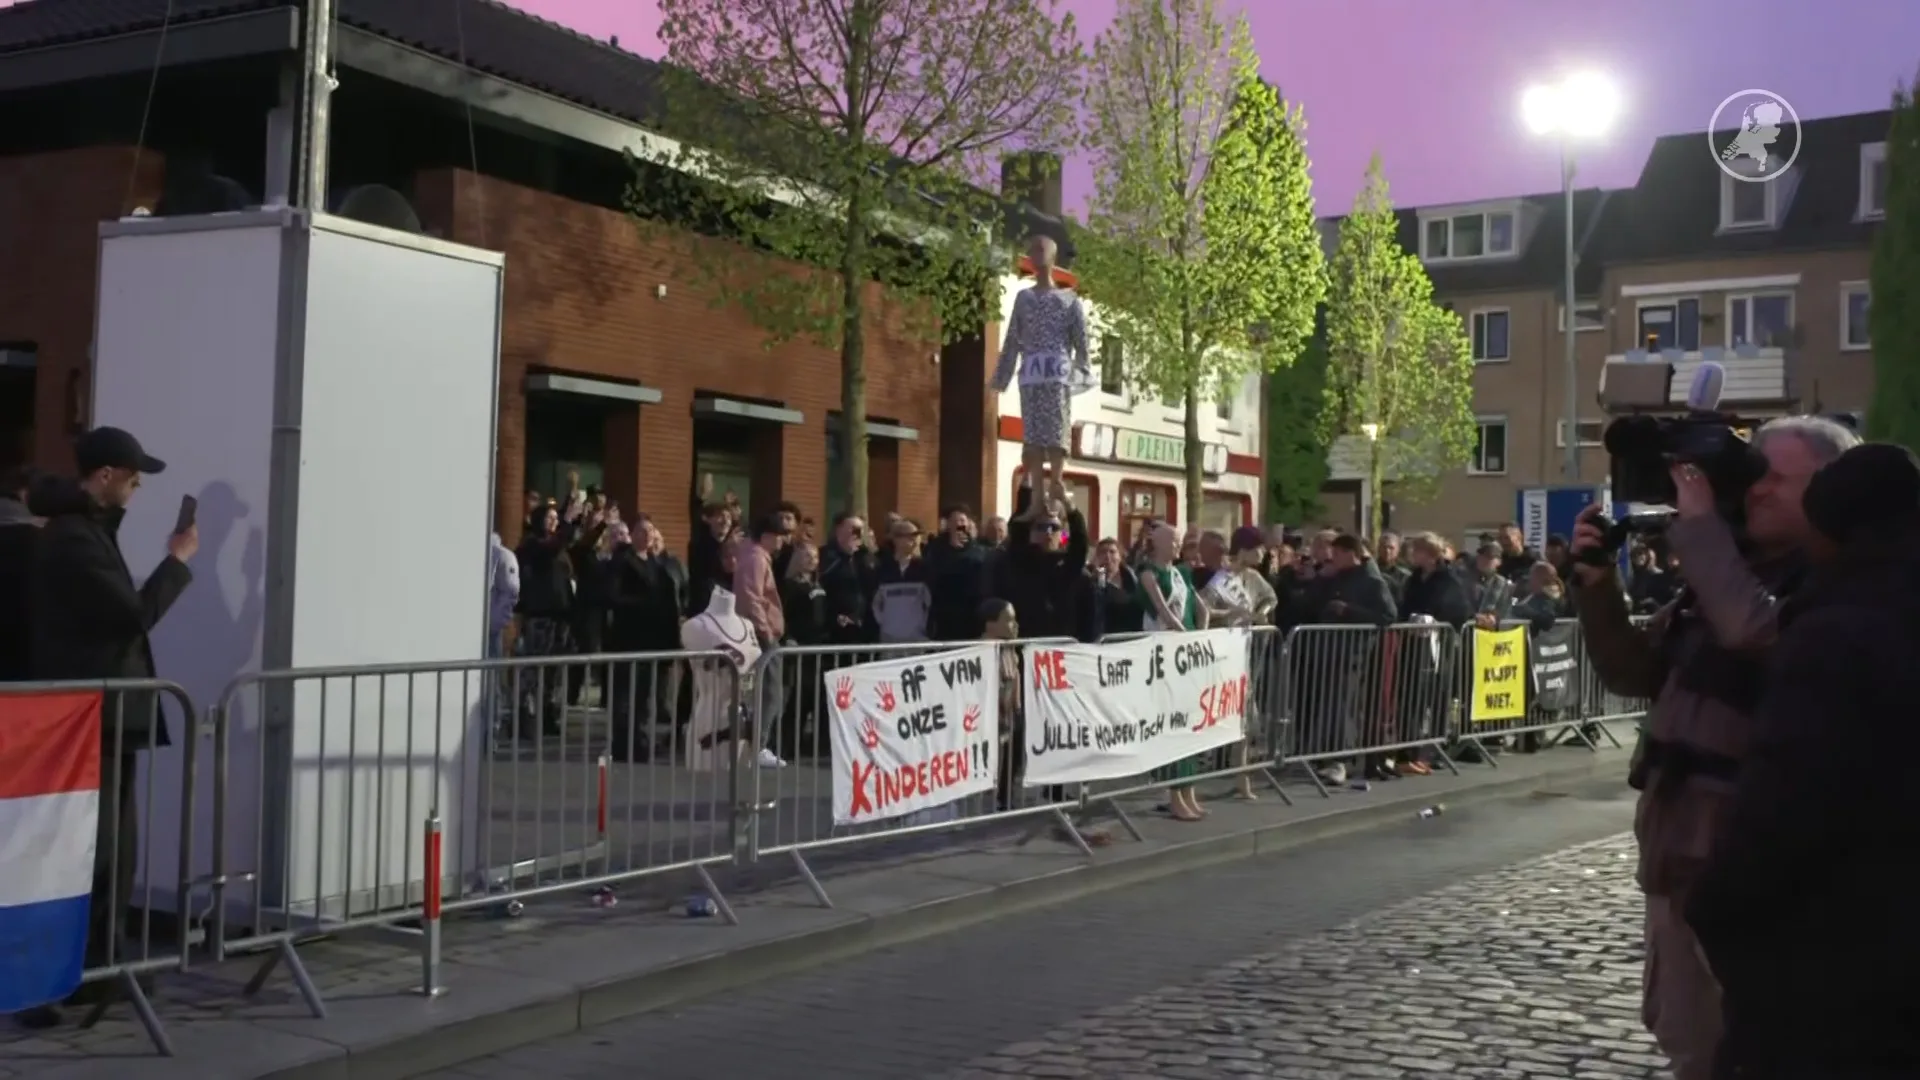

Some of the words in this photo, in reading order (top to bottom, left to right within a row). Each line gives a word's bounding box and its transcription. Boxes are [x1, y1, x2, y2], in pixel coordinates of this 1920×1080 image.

[1022, 355, 1068, 377] ARG
[1137, 434, 1184, 463] PLEINT
[901, 665, 926, 702] AF
[940, 656, 981, 689] VAN
[1034, 650, 1067, 689] ME
[1098, 654, 1132, 687] LAAT
[897, 704, 947, 739] ONZE
